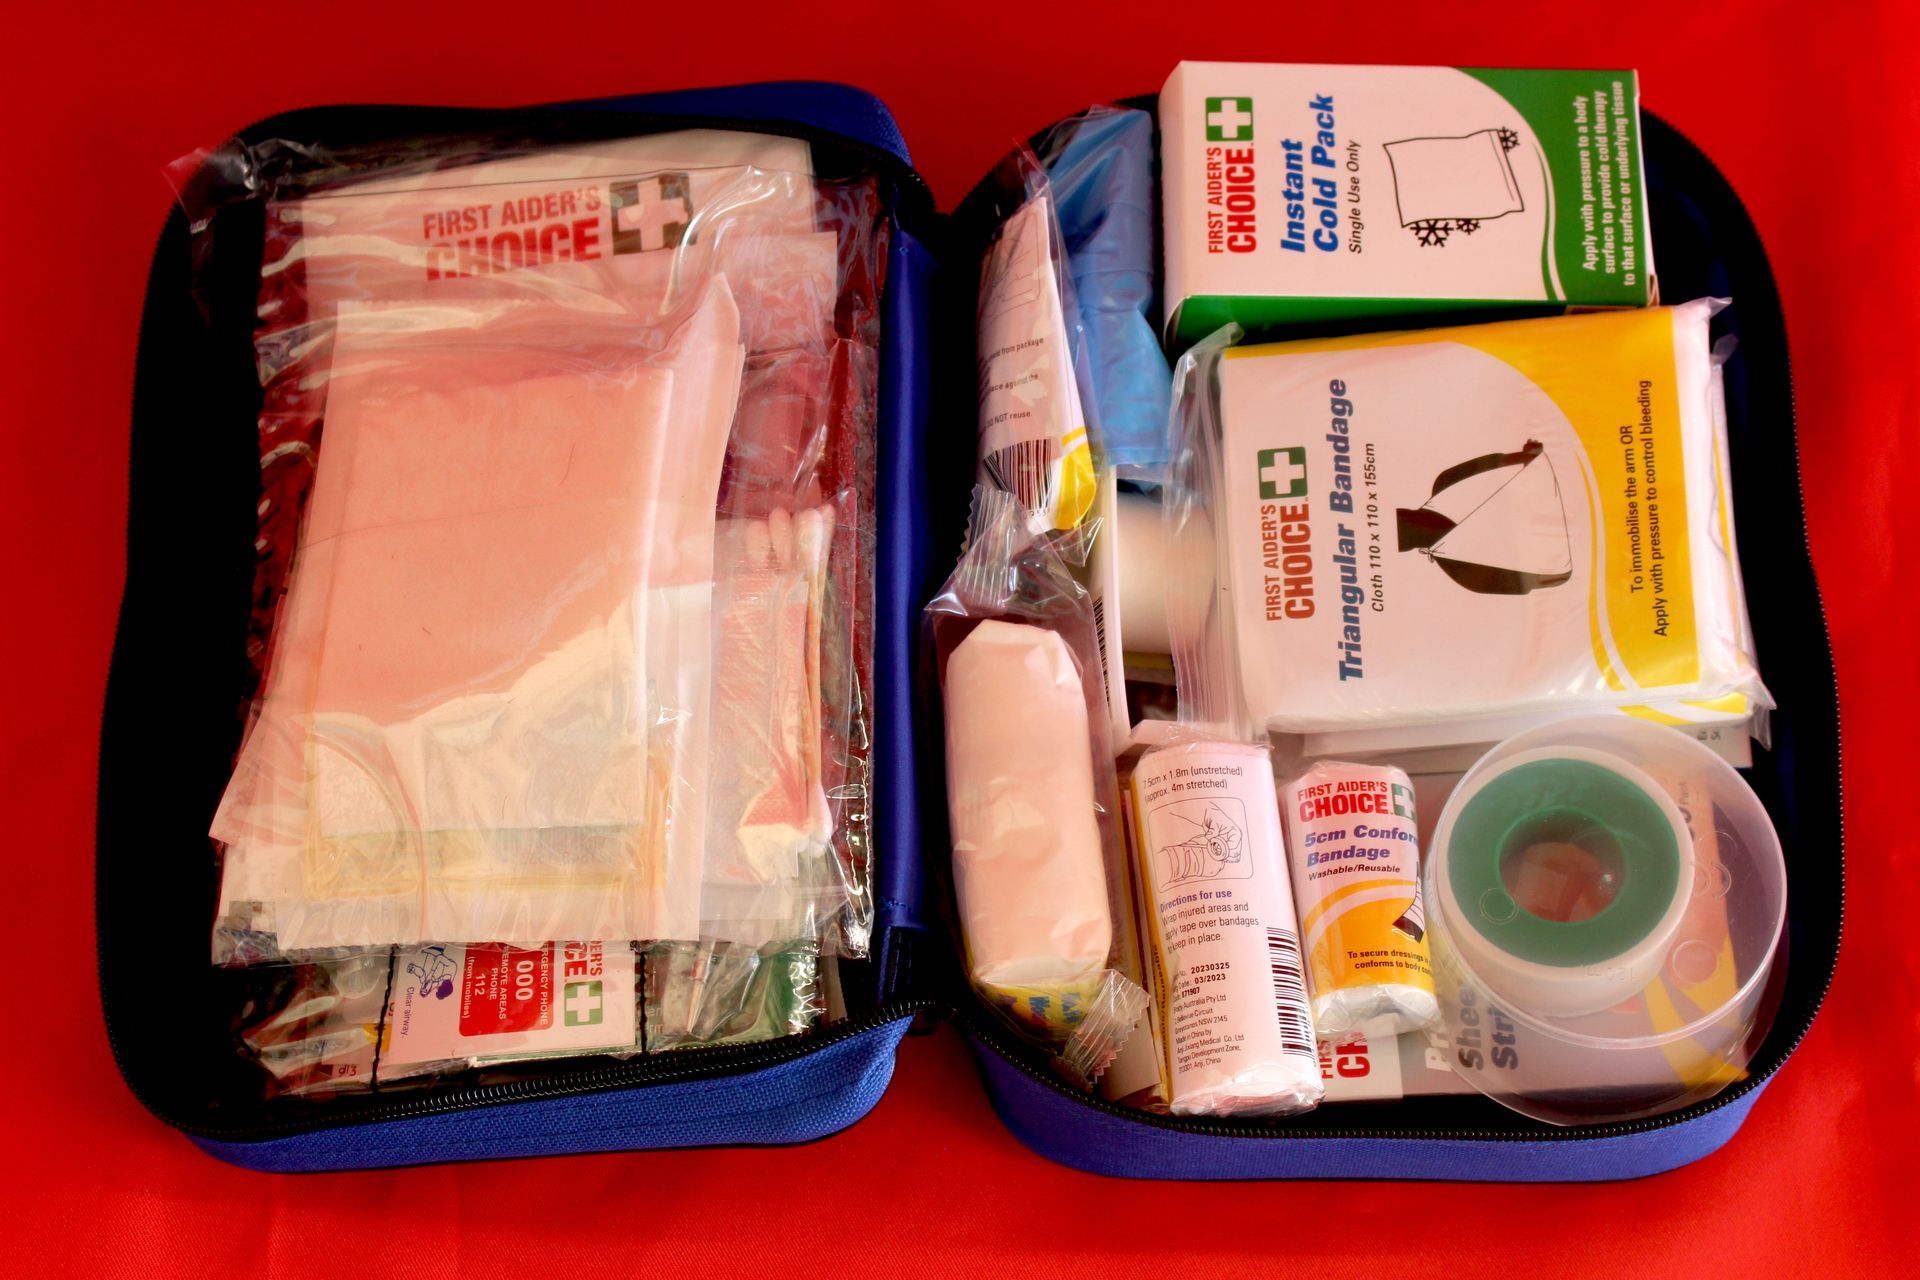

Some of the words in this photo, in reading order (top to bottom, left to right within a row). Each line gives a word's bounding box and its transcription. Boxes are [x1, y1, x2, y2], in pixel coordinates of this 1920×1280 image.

[1573, 95, 1589, 124] body
[1594, 90, 1608, 134] therapy
[1612, 81, 1625, 115] tissue
[1308, 93, 1336, 168] Pack
[1577, 125, 1588, 134] a
[1578, 135, 1589, 148] to
[1346, 140, 1362, 172] Only
[1595, 135, 1609, 162] cold
[1613, 117, 1630, 179] underlying
[1206, 147, 1223, 206] AIDER'S
[1347, 177, 1361, 203] Use
[1579, 150, 1596, 201] pressure
[1598, 164, 1616, 209] provide
[1620, 181, 1631, 195] or
[1225, 148, 1257, 253] CHOICE
[1280, 138, 1305, 253] Instant
[423, 204, 493, 240] FIRST
[501, 185, 601, 227] AIDER'S
[1312, 177, 1339, 252] Cold
[1580, 204, 1594, 232] with
[1602, 211, 1614, 224] to
[1619, 196, 1634, 244] surface
[1208, 211, 1223, 253] FIRST
[1348, 208, 1364, 254] Single
[426, 217, 602, 281] CHOICE
[1582, 234, 1599, 271] Apply
[1602, 225, 1616, 274] surface
[1621, 244, 1635, 271] that
[1624, 273, 1636, 286] to
[1016, 337, 1044, 352] package
[1638, 380, 1652, 436] bleeding
[1326, 378, 1354, 514] Bandage
[1620, 425, 1634, 446] OR
[1364, 443, 1377, 488] 155cm
[1625, 448, 1636, 475] arm
[1642, 437, 1657, 485] control
[1367, 492, 1377, 501] x
[1625, 476, 1637, 499] the
[1646, 487, 1657, 501] to
[1367, 503, 1379, 528] 110
[1260, 504, 1280, 569] AIDER'S
[1369, 533, 1379, 543] x
[1625, 501, 1643, 573] immobilise
[1648, 503, 1665, 564] pressure
[1280, 503, 1315, 619] CHOICE
[1368, 544, 1381, 569] 110
[1371, 574, 1384, 612] Cloth
[1631, 575, 1644, 593] To
[1649, 566, 1664, 597] with
[1265, 575, 1282, 621] FIRST
[1333, 523, 1365, 682] Triangular
[1652, 598, 1668, 637] Apply
[1162, 773, 1168, 781] x
[1169, 767, 1189, 778] 1.8m
[1190, 765, 1243, 776] (unstretched)
[1171, 783, 1184, 792] 4m
[1186, 778, 1228, 790] stretched)
[1298, 783, 1333, 801] FIRST
[1337, 780, 1388, 793] AIDER'S
[1299, 793, 1389, 822] CHOICE
[1305, 829, 1346, 848] 5cm
[1307, 845, 1391, 867] Bandage
[1308, 863, 1401, 881] Washable/Reusable
[1199, 889, 1213, 900] for
[1215, 889, 1232, 899] use
[1178, 906, 1206, 920] injured
[1208, 903, 1232, 913] areas
[1233, 902, 1249, 912] and
[1179, 921, 1198, 934] tape
[1198, 918, 1217, 928] over
[1219, 915, 1259, 928] bandages
[1188, 934, 1196, 945] in
[465, 956, 476, 981] (from
[1191, 962, 1230, 974] 20230325
[1347, 951, 1358, 959] To
[1354, 960, 1394, 969] conforms
[1395, 960, 1404, 968] to
[474, 972, 486, 996] 112
[489, 967, 499, 1000] PHONE
[515, 960, 534, 1001] 000
[1194, 973, 1226, 985] 03/2023
[405, 986, 415, 1008] Clear
[461, 981, 473, 1019] mobiles)
[498, 987, 508, 1020] AREAS
[539, 991, 549, 1025] PHONE
